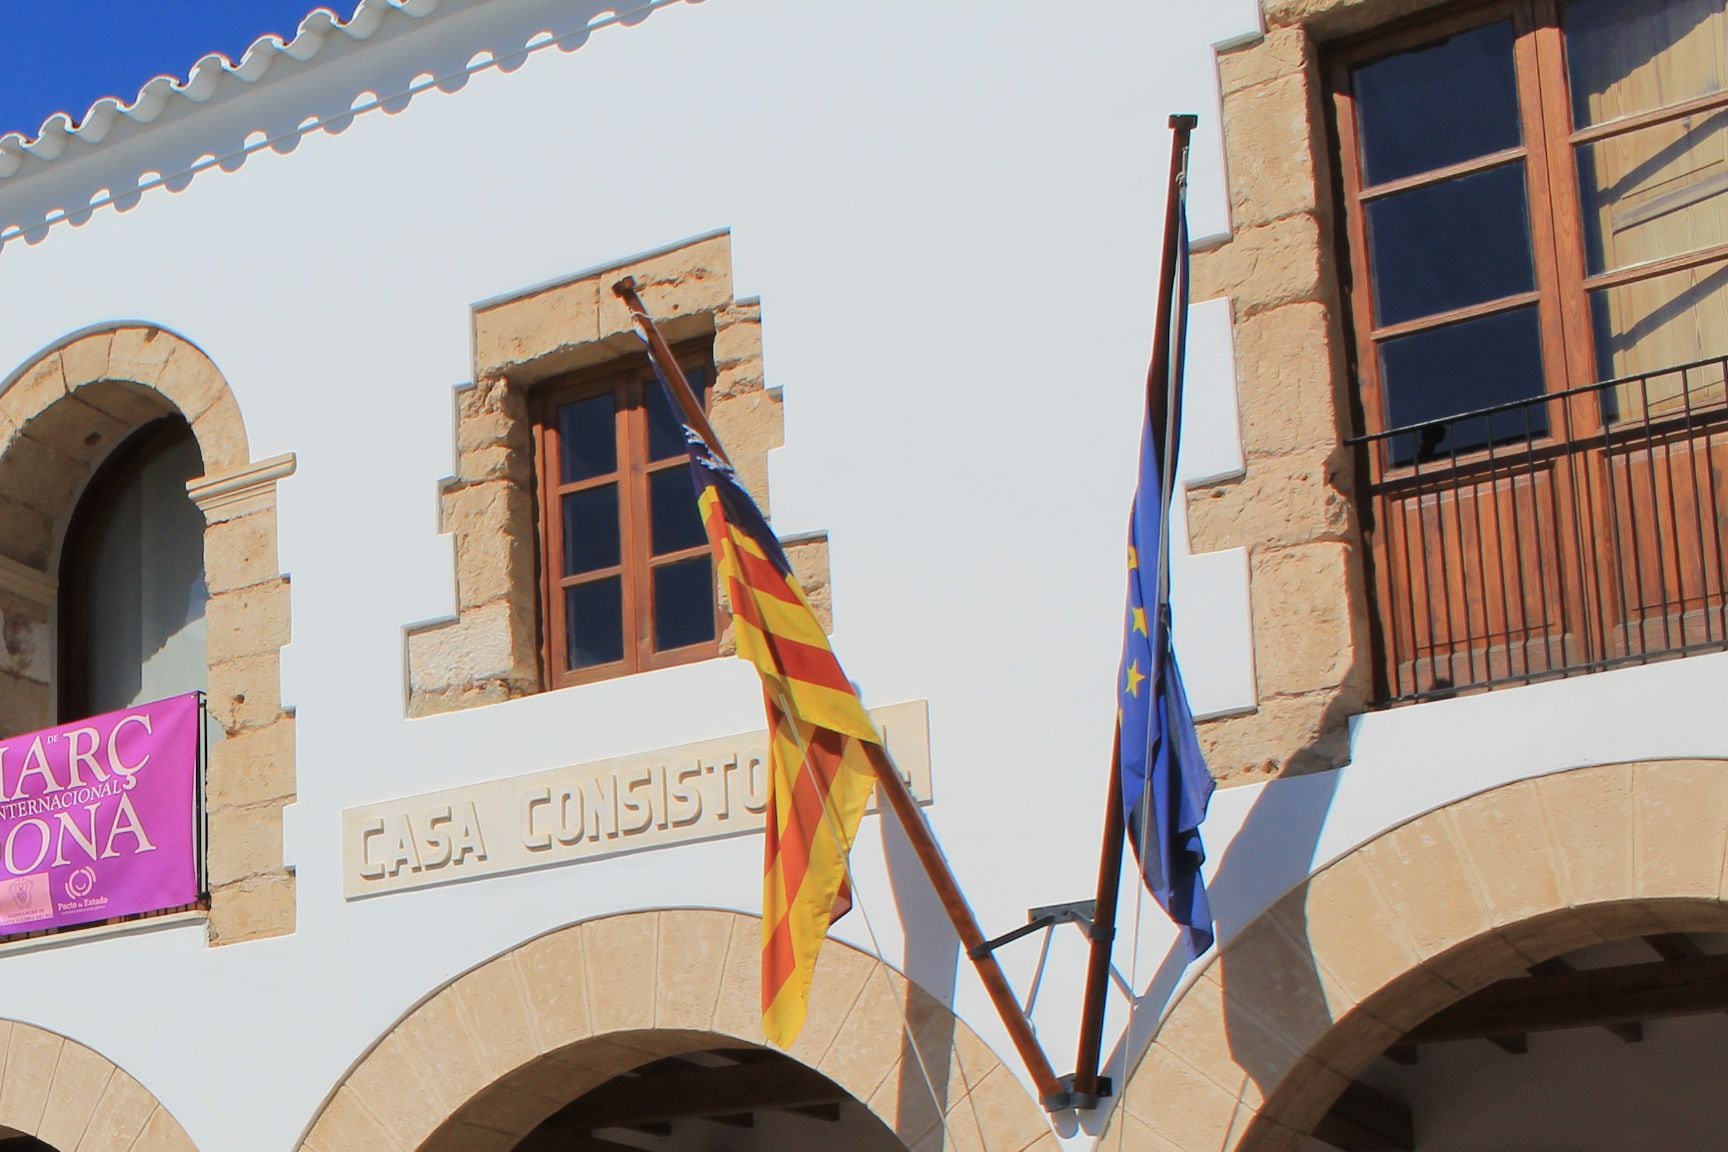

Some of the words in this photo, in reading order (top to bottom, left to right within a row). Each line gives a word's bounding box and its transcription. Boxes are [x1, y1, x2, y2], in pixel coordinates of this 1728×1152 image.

[46, 734, 60, 745] DE
[358, 800, 488, 881] CASA
[58, 901, 77, 912] Pacto
[84, 895, 109, 907] Estado
